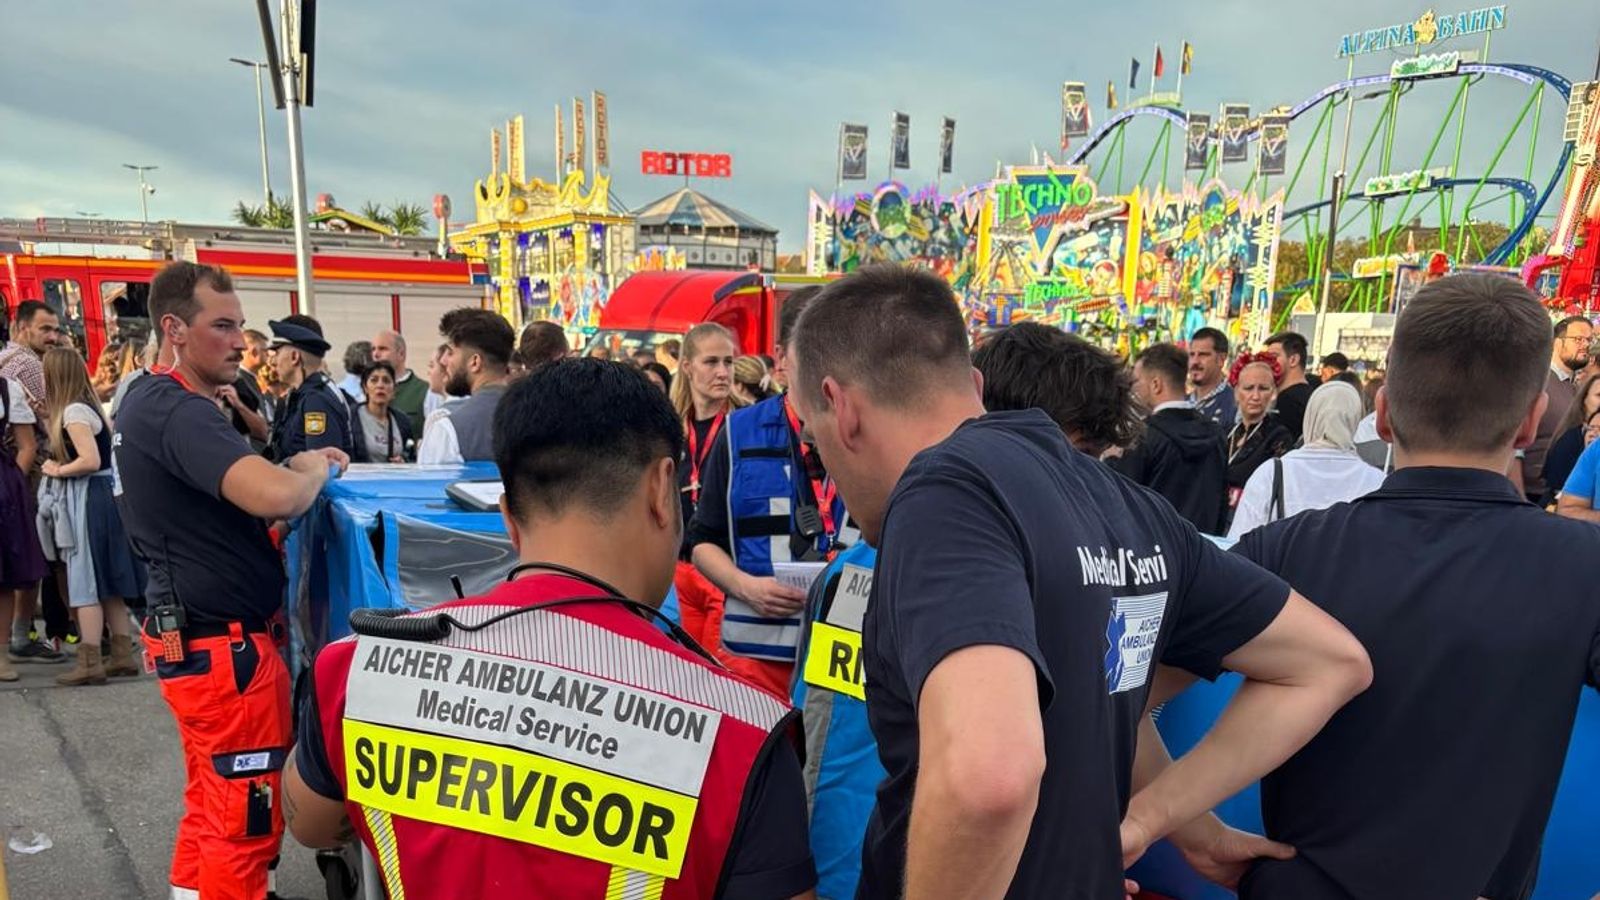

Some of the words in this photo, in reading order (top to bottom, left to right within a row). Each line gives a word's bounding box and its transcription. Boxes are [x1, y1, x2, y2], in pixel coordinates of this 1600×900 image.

[1437, 6, 1505, 38] BAHN
[641, 151, 732, 177] ROTOR
[995, 168, 1092, 224] TECHNO
[364, 645, 454, 683] AICHER
[456, 657, 609, 716] AMBULANZ
[614, 690, 708, 743] UNION
[416, 689, 513, 733] Medical
[516, 706, 618, 760] Service
[355, 737, 675, 860] SUPERVISOR
